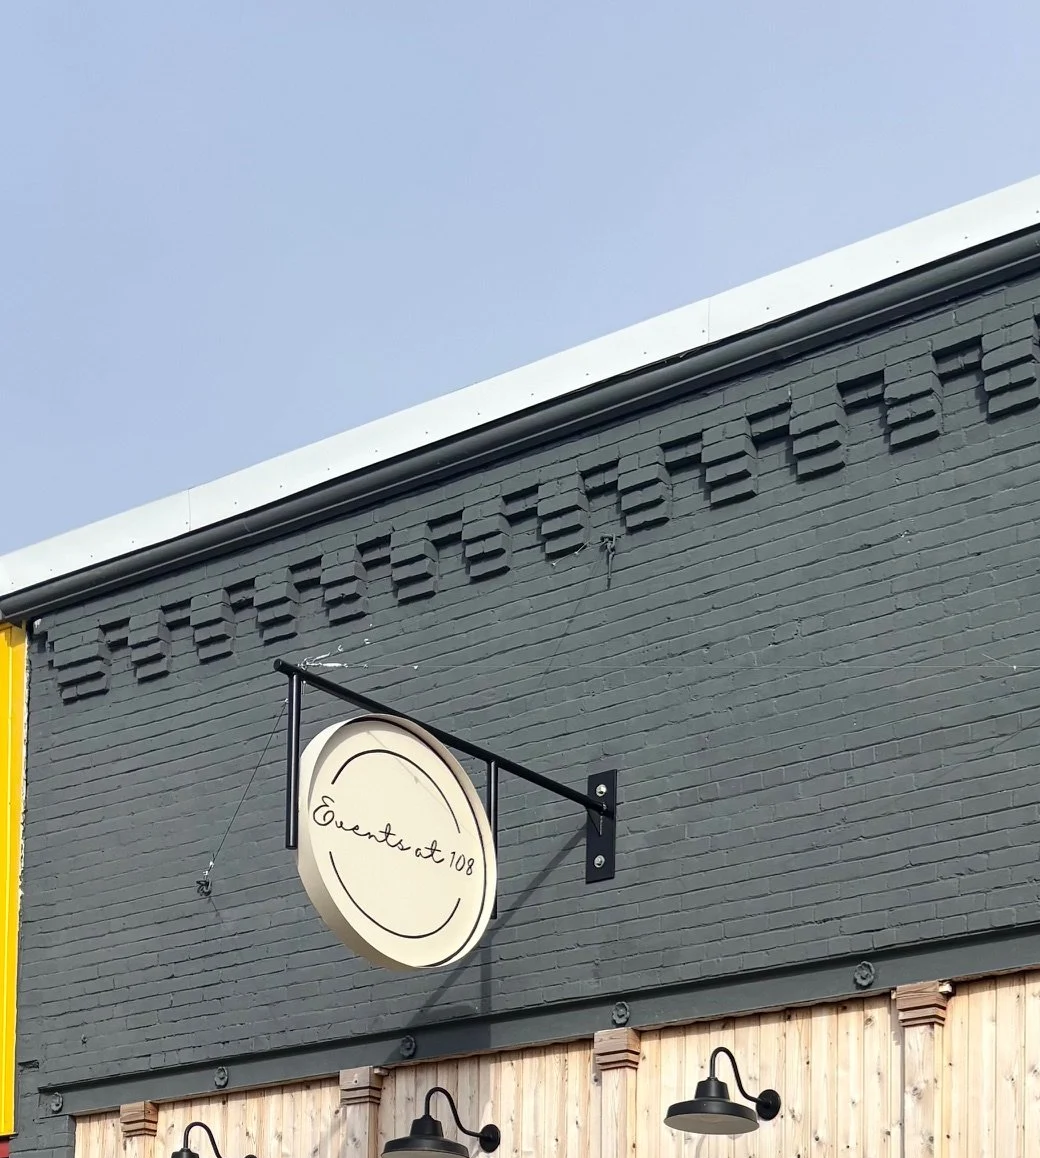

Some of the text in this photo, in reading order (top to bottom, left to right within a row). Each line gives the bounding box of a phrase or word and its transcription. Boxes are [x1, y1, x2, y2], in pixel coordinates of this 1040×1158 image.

[312, 795, 475, 876] Events at 108
